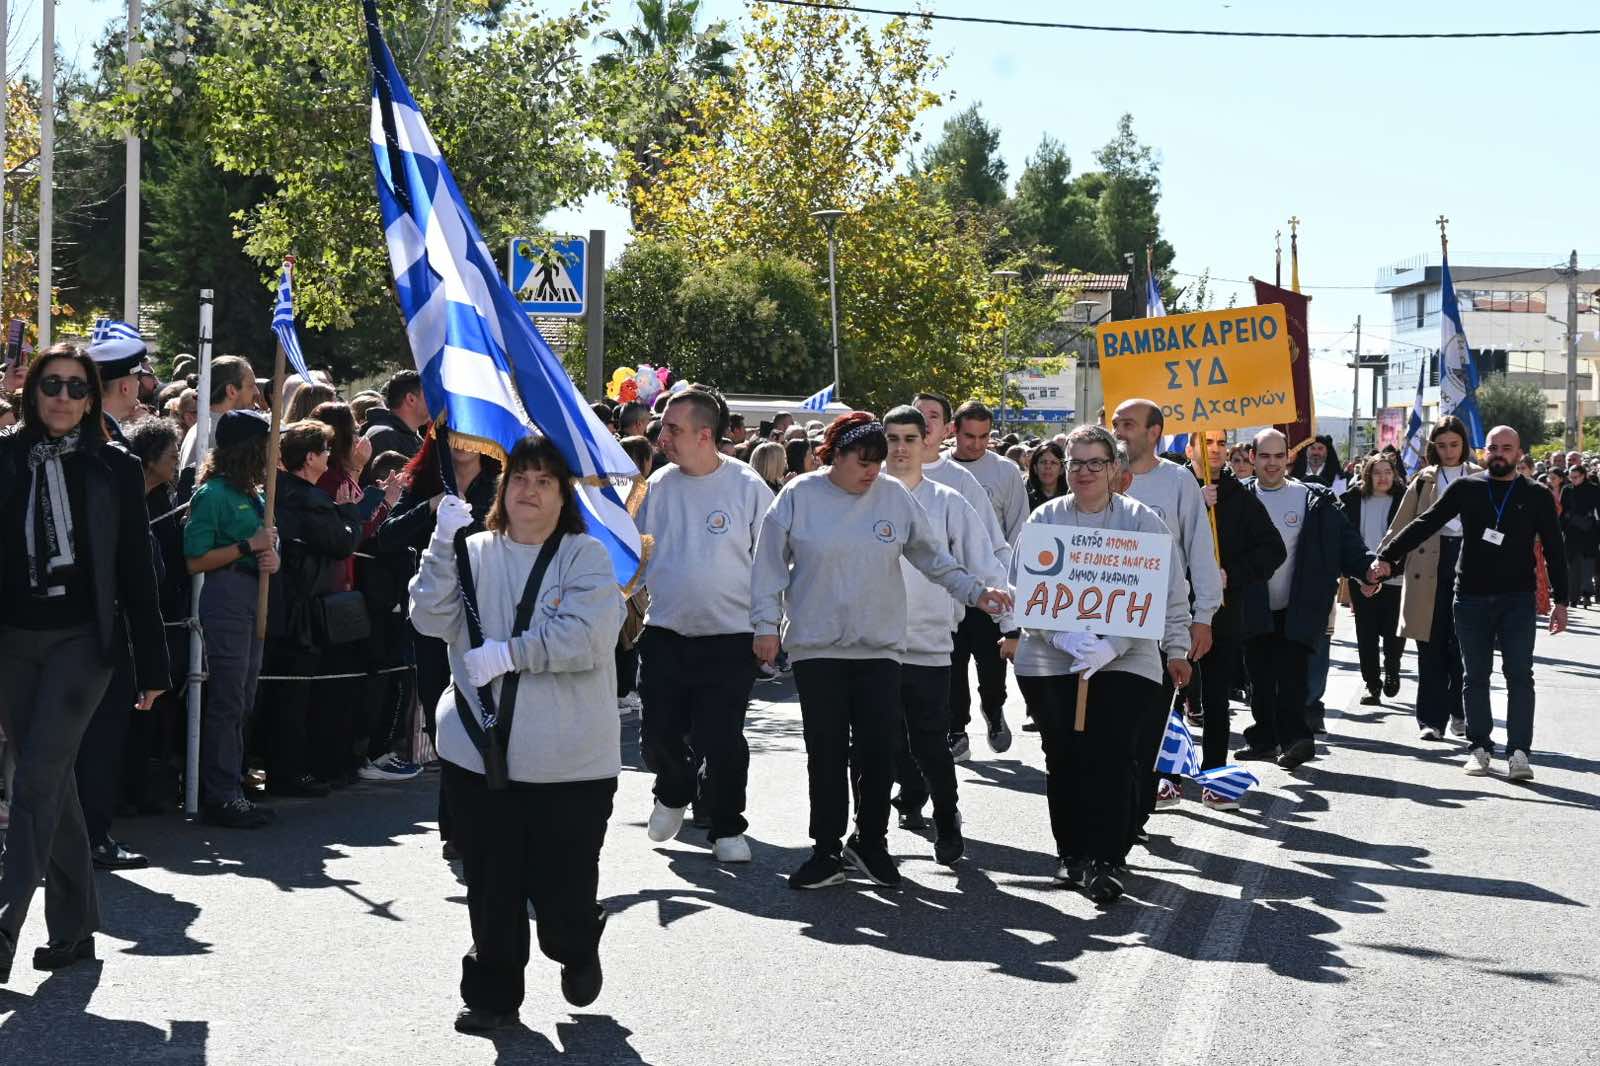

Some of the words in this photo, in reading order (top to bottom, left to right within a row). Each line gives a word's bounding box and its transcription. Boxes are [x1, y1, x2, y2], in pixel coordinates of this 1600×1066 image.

[1103, 315, 1278, 358] ΒΑΜΒΑΚΑΡΕΙΟ
[1165, 356, 1229, 390] ΣΥΔ
[1191, 390, 1286, 422] Αχαρνών
[1071, 534, 1103, 549] ΚΕΝΤΡΟ
[1105, 536, 1139, 552] ΑΤΟΜΩΝ
[1068, 568, 1098, 583] ΔΗΜΟΥ
[1100, 571, 1140, 586] ΑΧΑΡΝΩΝ
[1069, 551, 1082, 564] ΜΕ
[1083, 552, 1120, 568] ΕΙΔΙΚΕΣ
[1122, 555, 1161, 571] ΑΝΑΓΚΕΣ
[1025, 580, 1153, 628] ΑΡΩΓΗ
